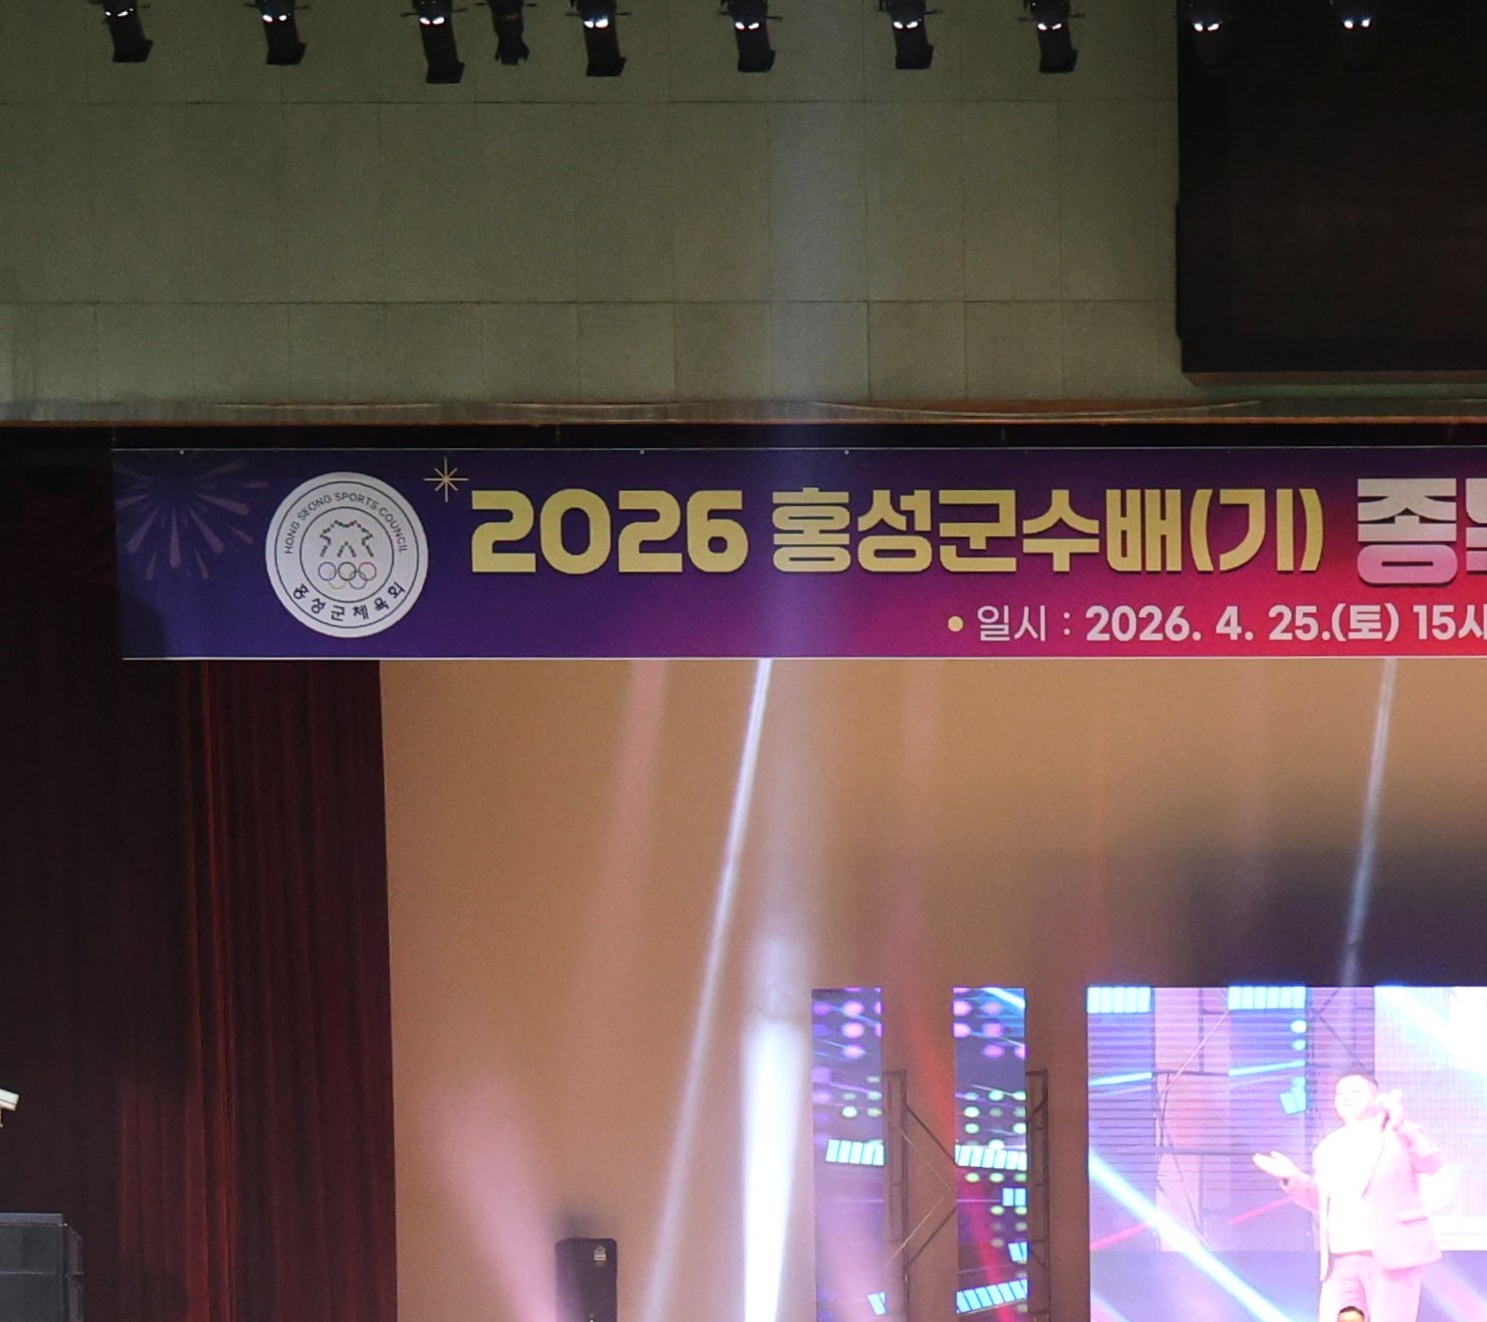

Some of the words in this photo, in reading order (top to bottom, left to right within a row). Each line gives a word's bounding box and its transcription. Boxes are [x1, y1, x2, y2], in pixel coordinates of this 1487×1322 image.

[284, 520, 301, 555] HONG
[297, 494, 333, 522] SEONG
[334, 492, 379, 510] SPORTS
[379, 507, 409, 553] COUNCIL
[471, 488, 748, 575] 2026
[771, 486, 1325, 574] 홍성군수배(기)
[977, 605, 1047, 642] 일시
[1085, 605, 1201, 642] 2026.
[1215, 605, 1253, 641] 4.
[1268, 603, 1400, 643] 25.(토)
